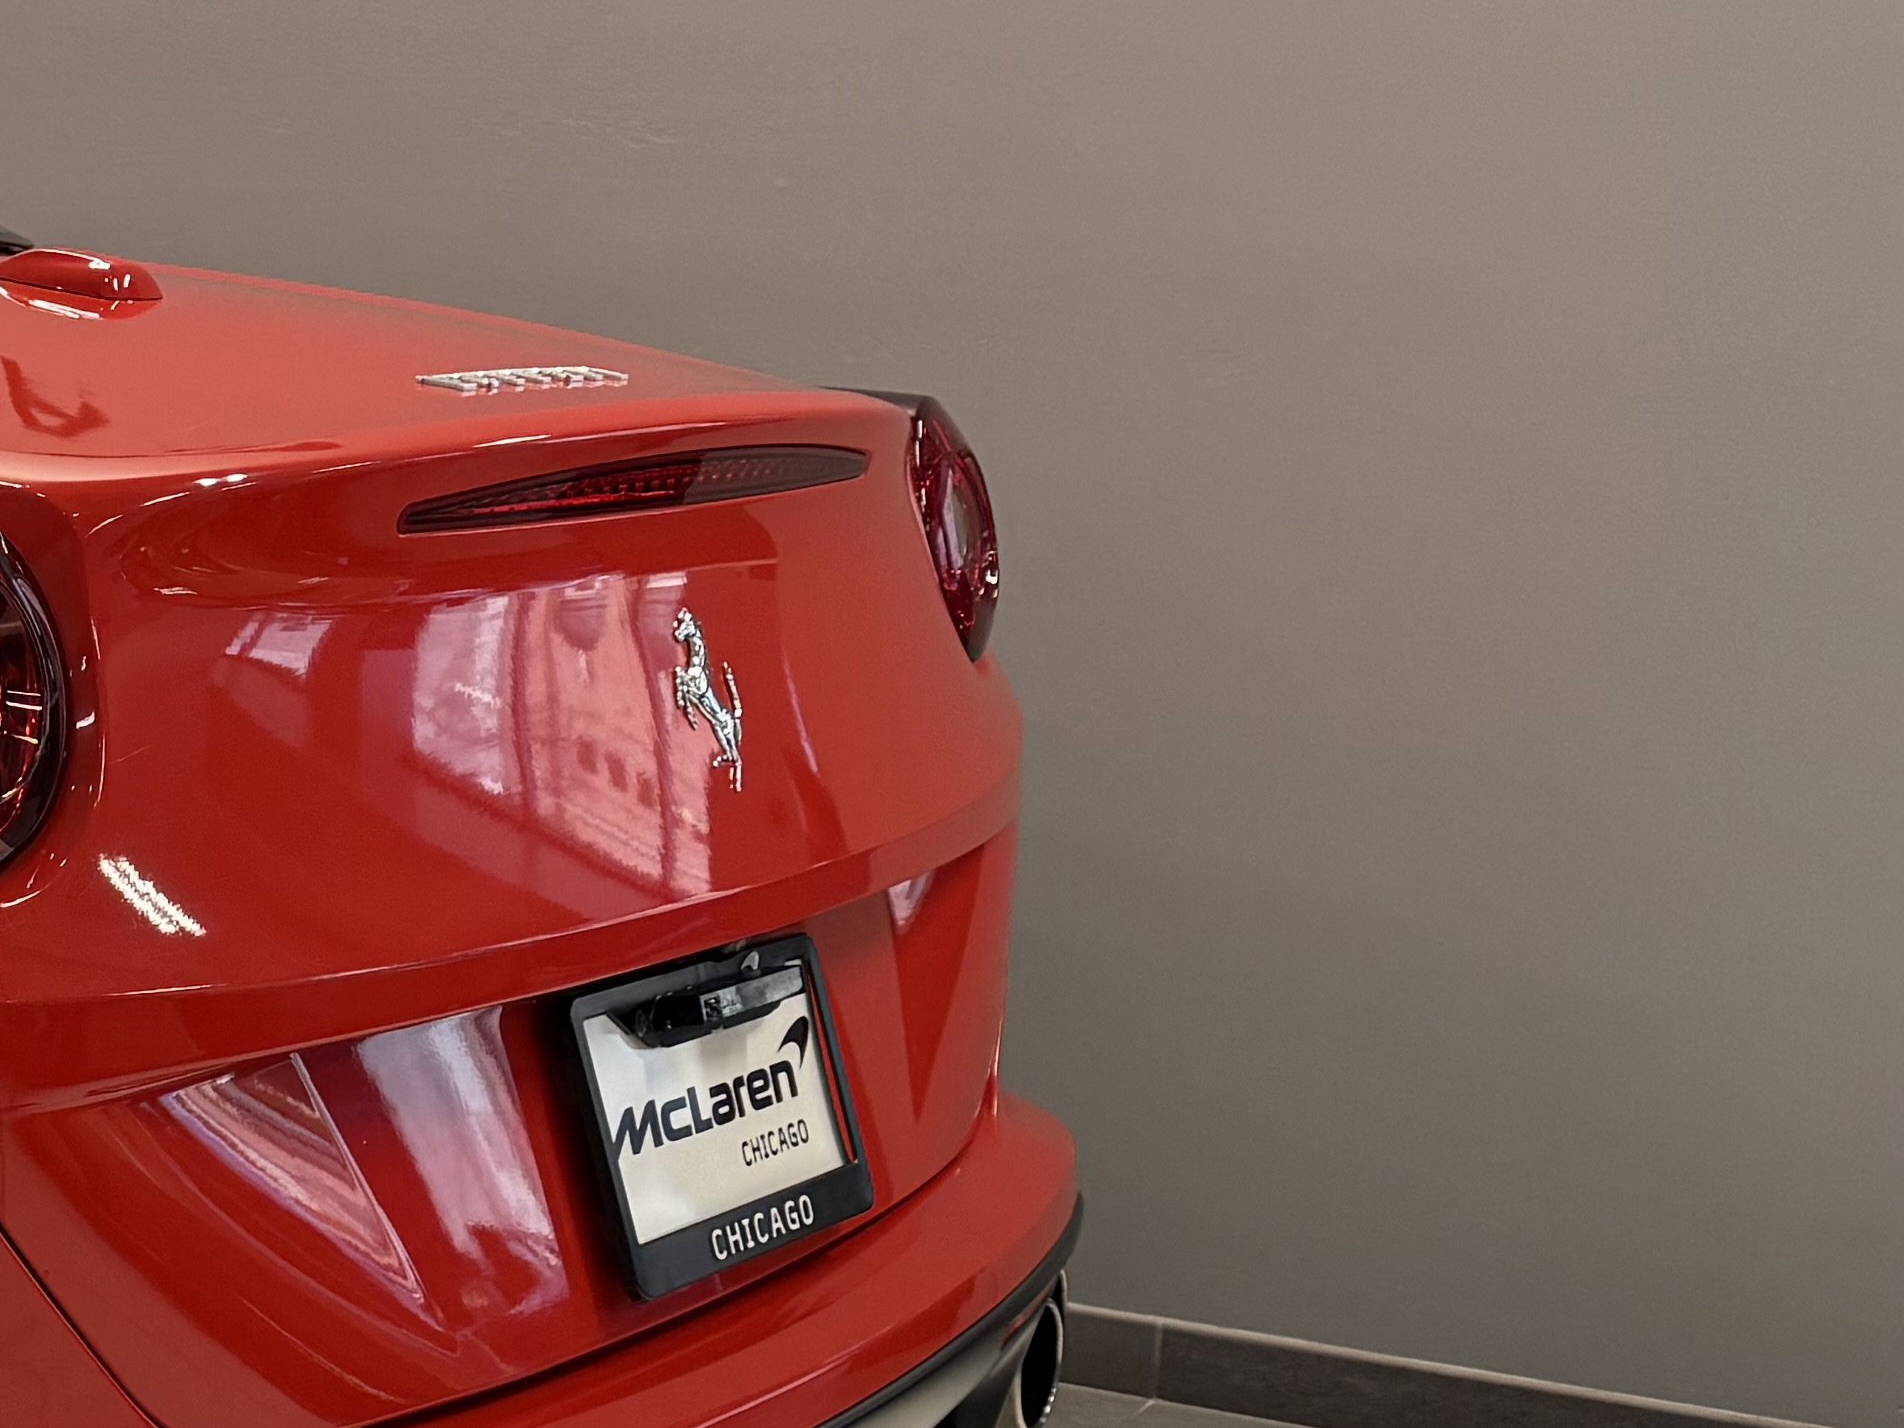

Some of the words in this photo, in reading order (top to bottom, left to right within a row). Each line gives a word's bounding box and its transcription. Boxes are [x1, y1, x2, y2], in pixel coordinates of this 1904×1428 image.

[613, 1059, 799, 1162] McLaren
[741, 1118, 809, 1167] CHICAGO
[711, 1194, 815, 1261] CHICAGO
